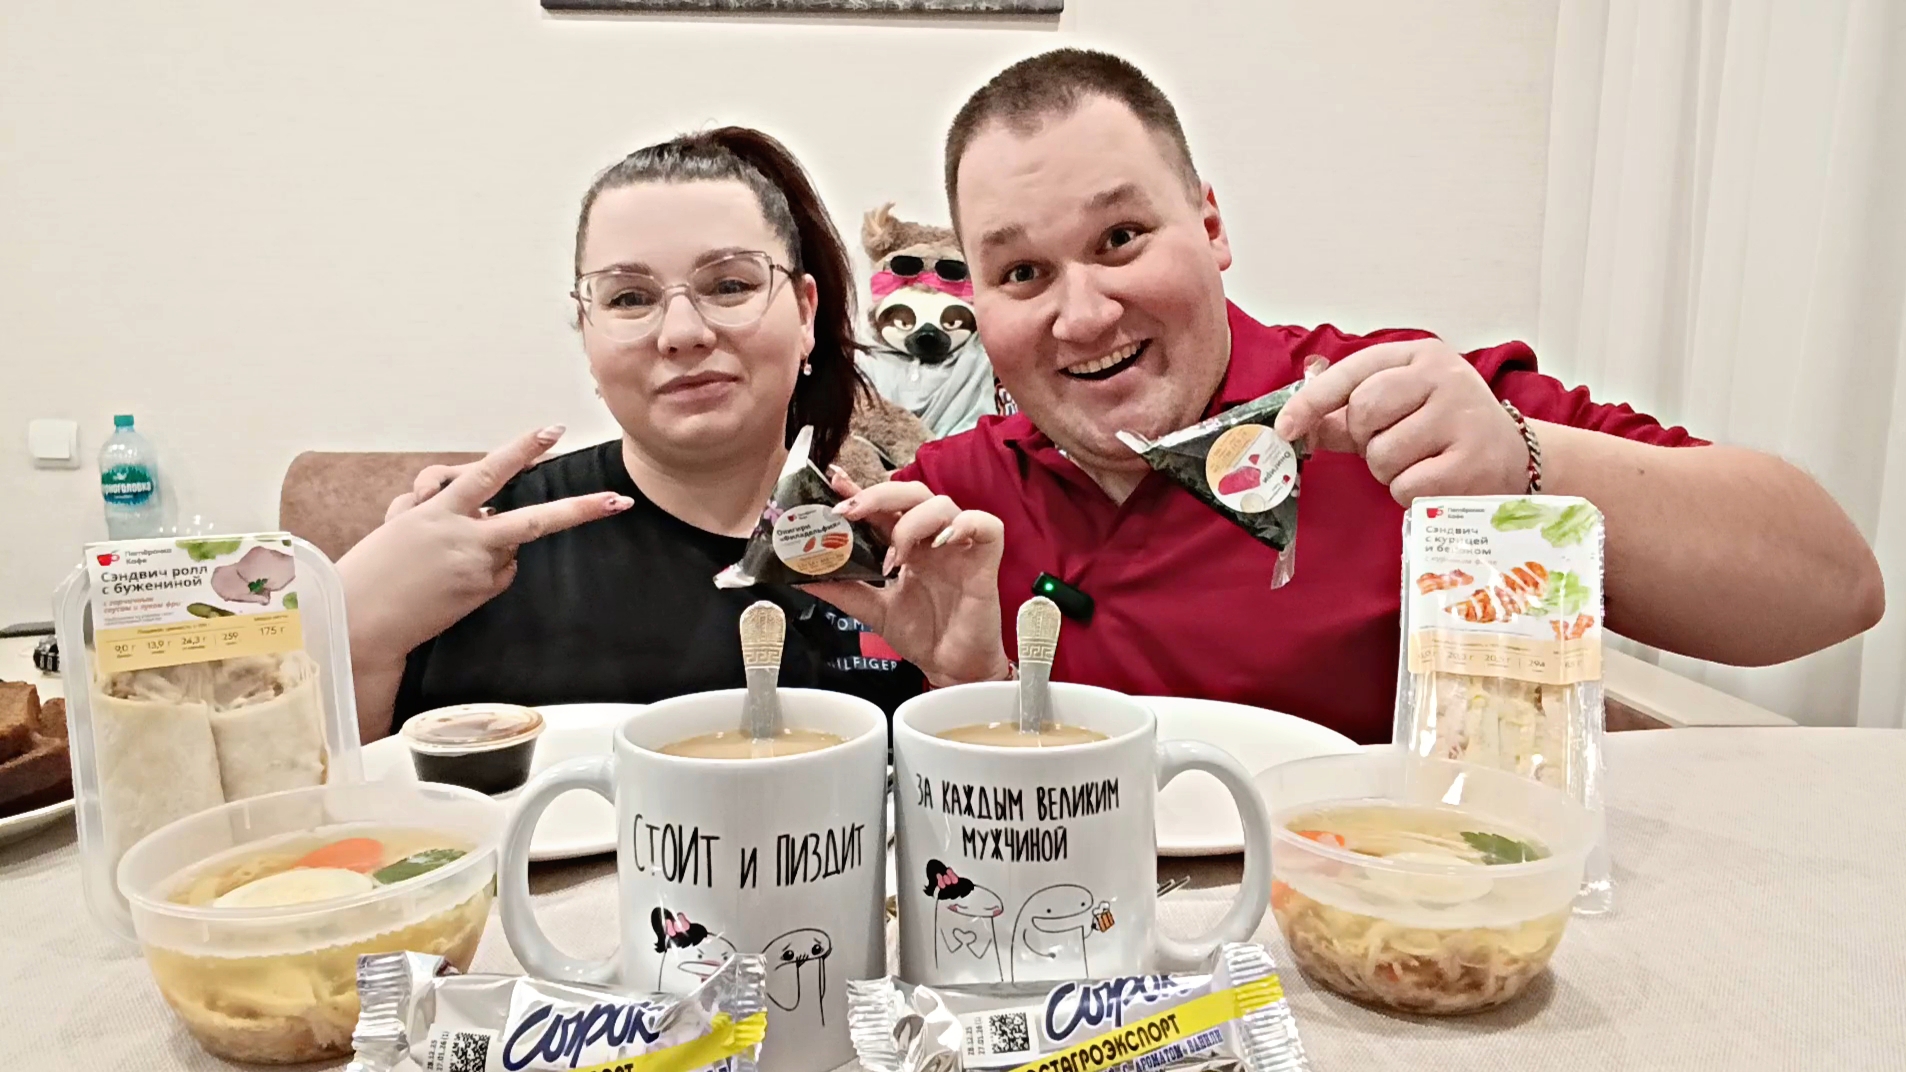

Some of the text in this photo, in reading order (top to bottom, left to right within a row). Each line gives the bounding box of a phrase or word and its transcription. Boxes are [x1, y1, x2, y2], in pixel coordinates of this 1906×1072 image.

[776, 524, 812, 536] Онигири
[1425, 526, 1479, 535] Сэндвич
[101, 565, 208, 583] Сэндвич ролл
[101, 575, 203, 595] с бужениной
[825, 611, 873, 631] TOM
[260, 627, 278, 636] 175
[916, 773, 1120, 822] ЗА КАЖДЫМ ВЕЛИКИМ
[633, 813, 721, 888] СТОИТ
[776, 822, 865, 887] ПИЗДИТ
[961, 825, 1068, 863] МУЖЧИНОЙ
